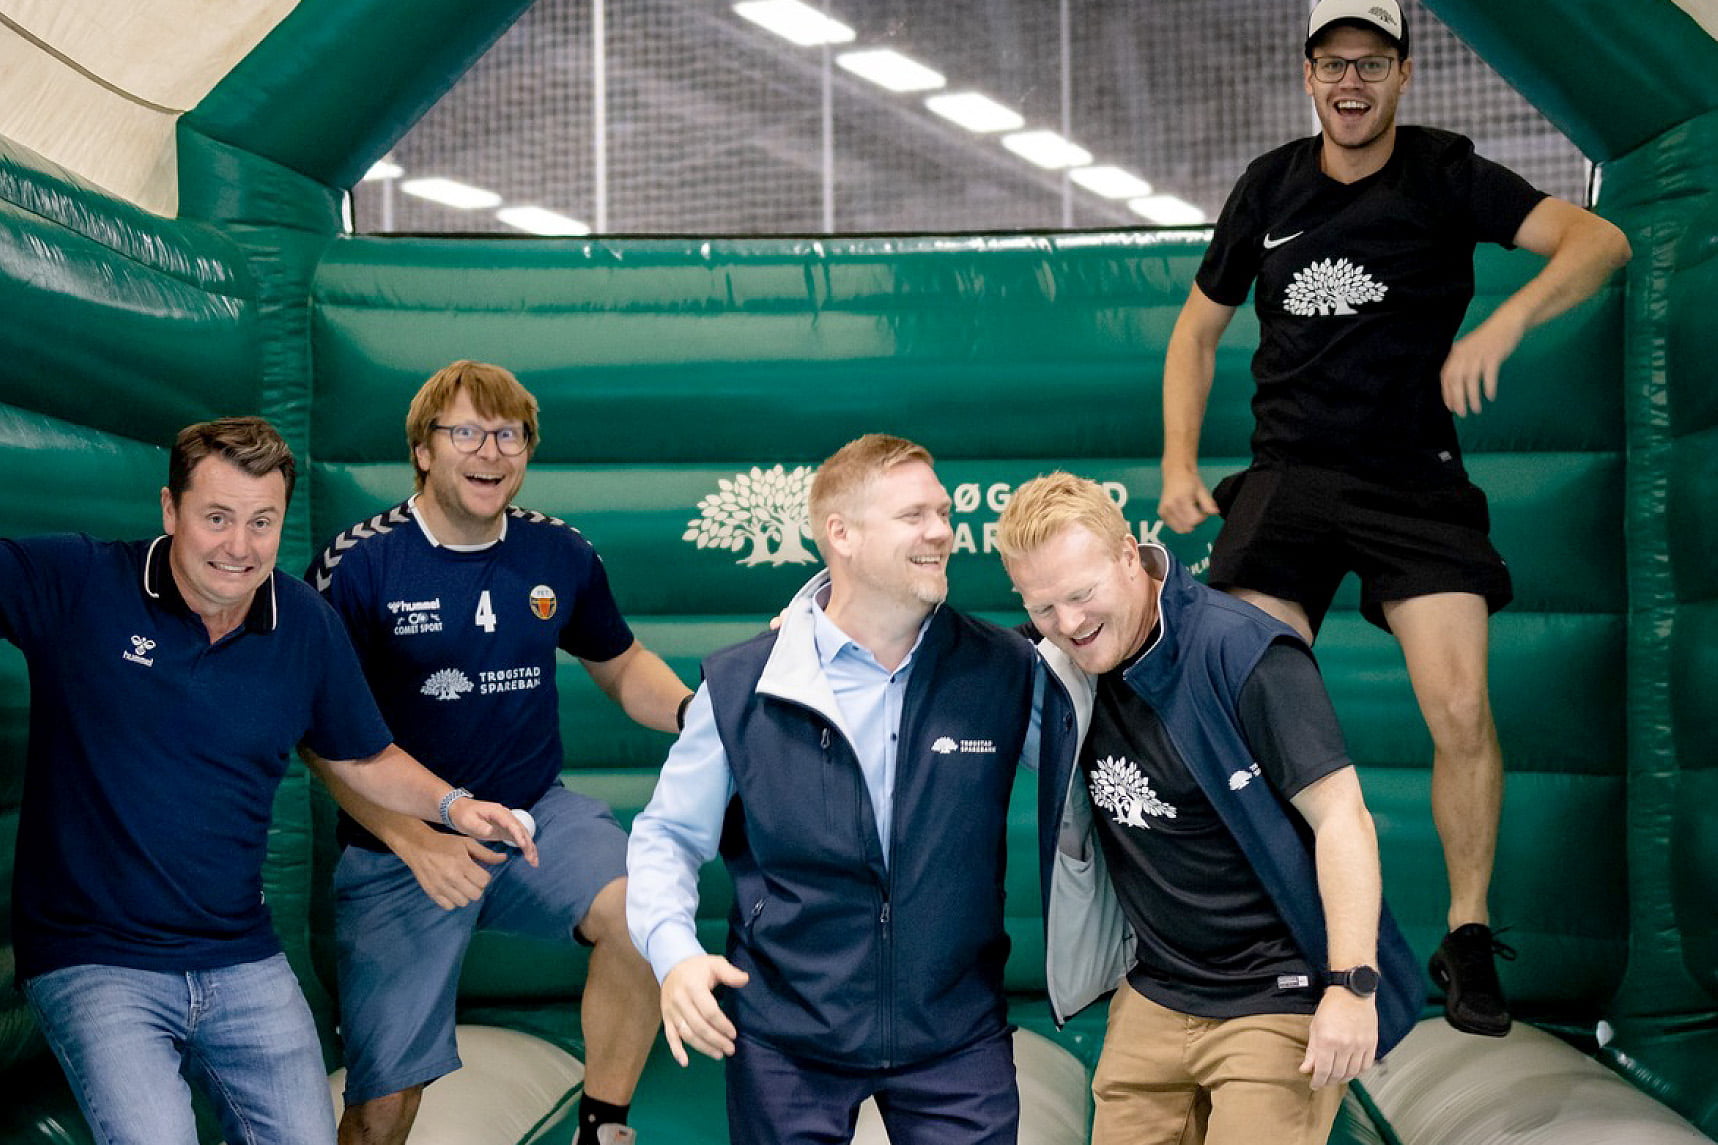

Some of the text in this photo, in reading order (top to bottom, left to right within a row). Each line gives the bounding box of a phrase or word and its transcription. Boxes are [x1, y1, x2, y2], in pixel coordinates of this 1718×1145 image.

[401, 597, 440, 612] hummel
[475, 589, 497, 633] 4
[394, 622, 443, 635] COMET SPORT
[479, 666, 541, 683] TRØGSTAD
